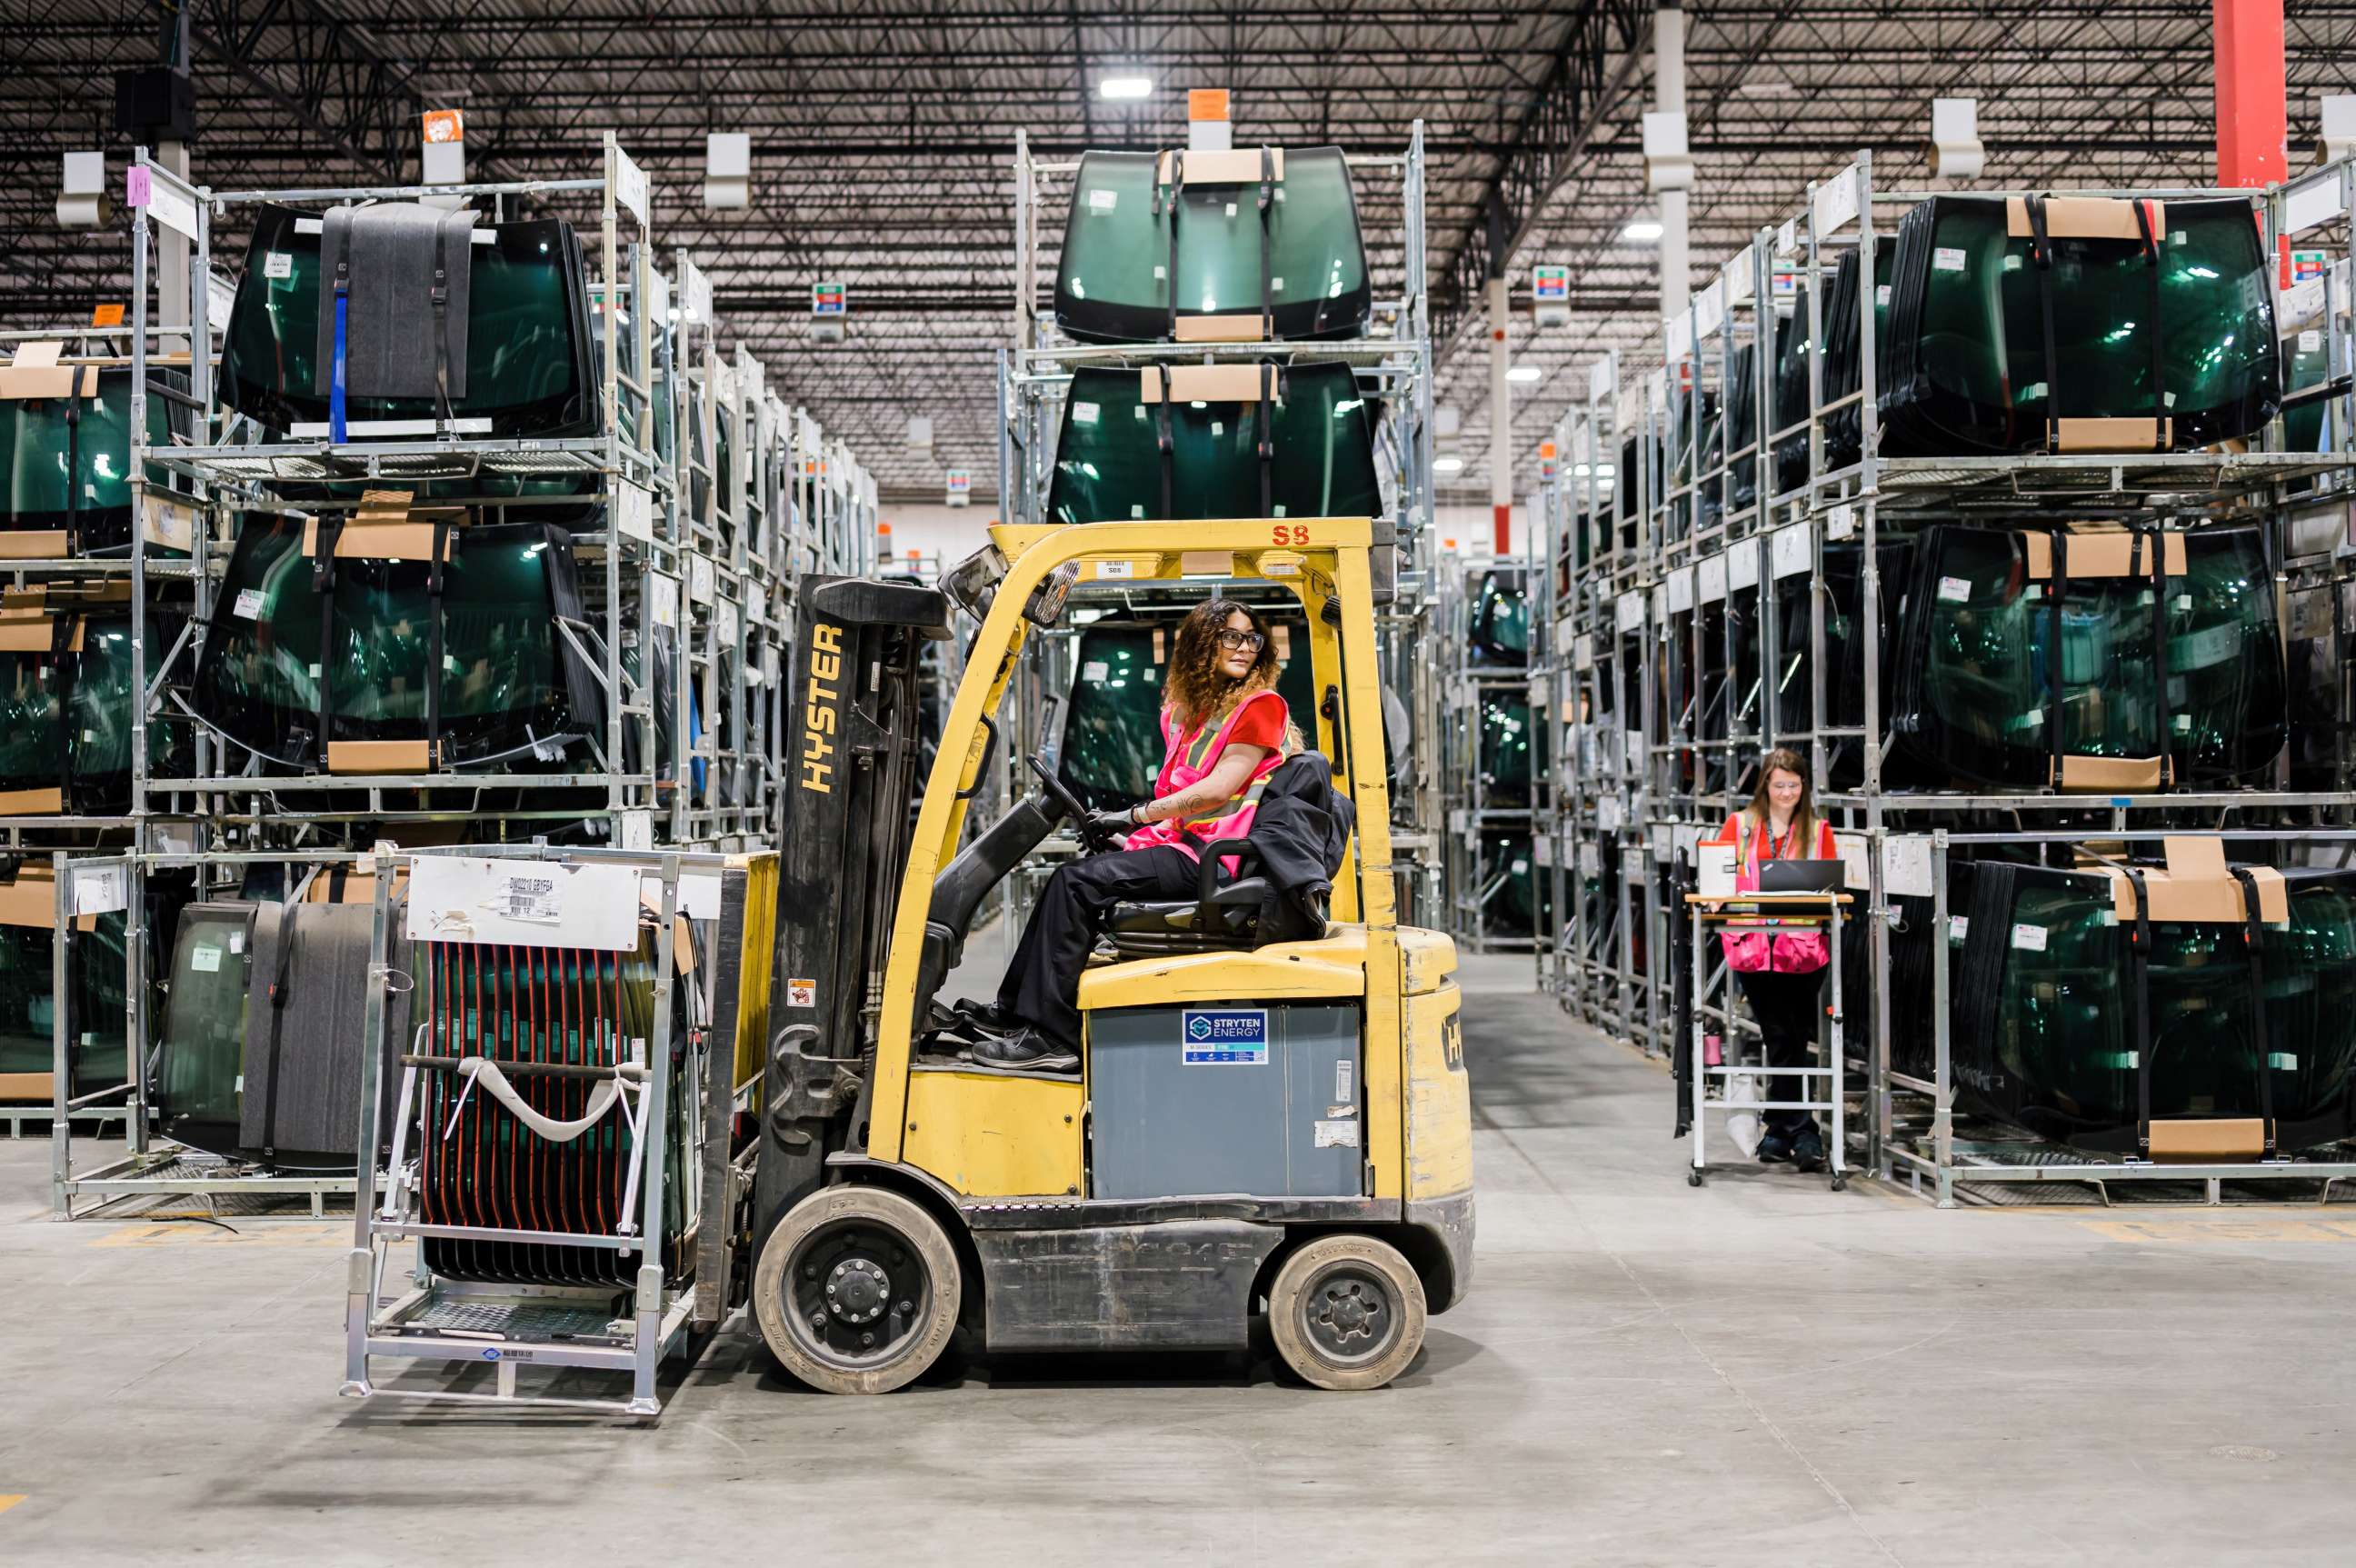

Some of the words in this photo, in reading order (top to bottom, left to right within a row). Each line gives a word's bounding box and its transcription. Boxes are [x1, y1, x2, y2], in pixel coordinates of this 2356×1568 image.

[1273, 524, 1309, 545] S8
[802, 624, 843, 794] HYSTER
[1213, 1018, 1261, 1027] STRYTEN
[1213, 1028, 1261, 1036] ENERGY
